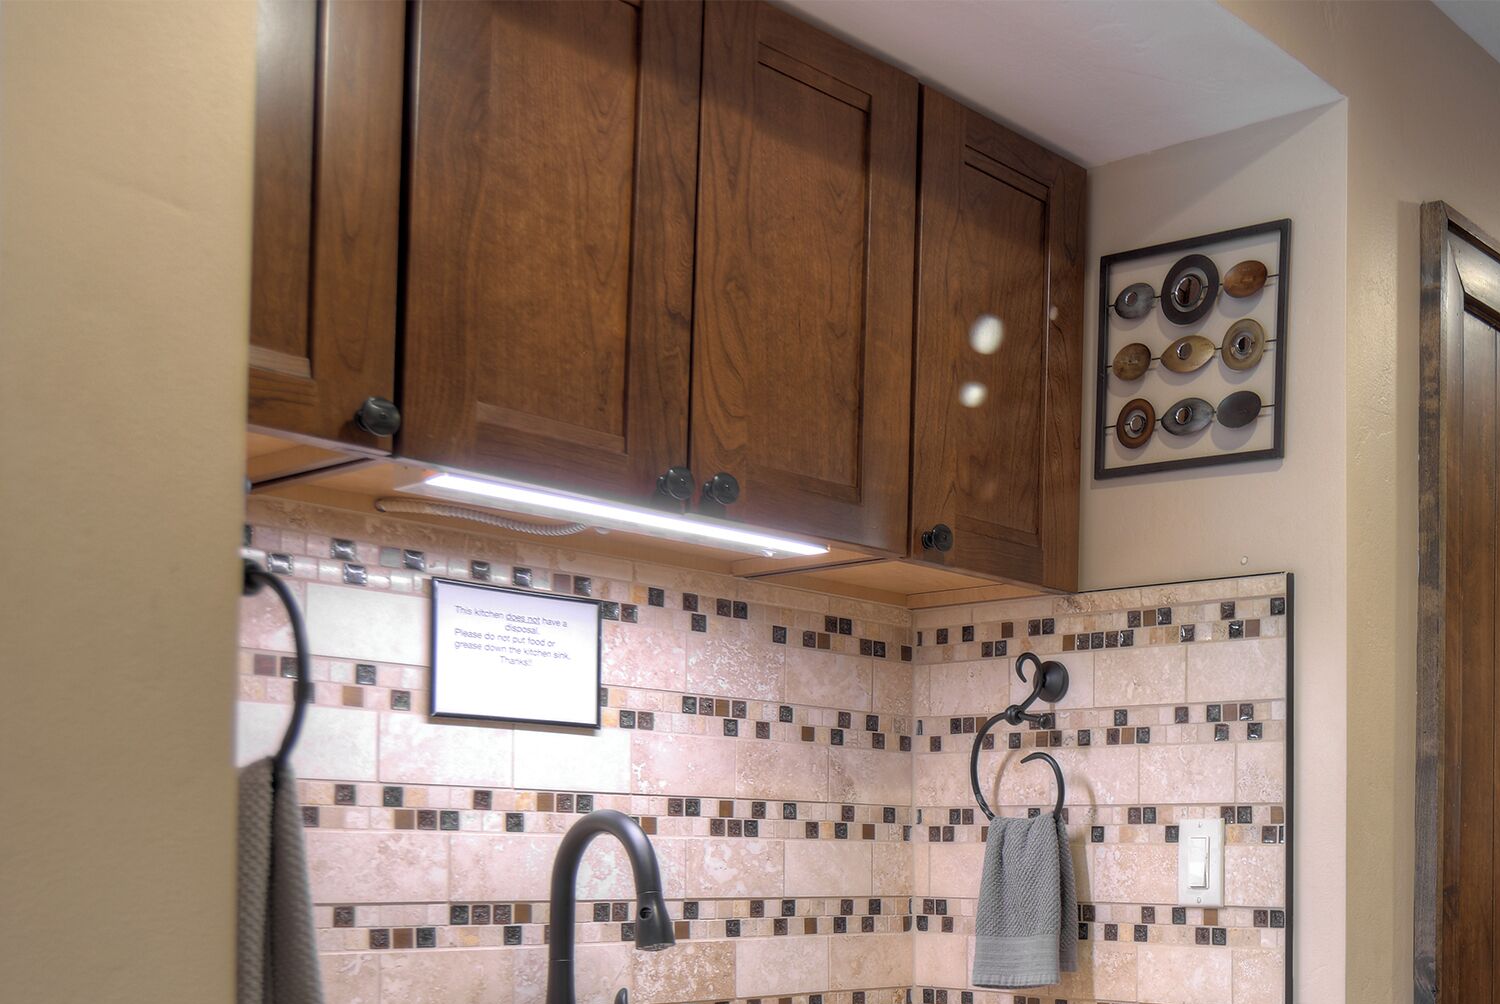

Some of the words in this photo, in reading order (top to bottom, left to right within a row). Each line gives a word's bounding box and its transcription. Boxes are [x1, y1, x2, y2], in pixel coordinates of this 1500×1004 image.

[455, 605, 472, 615] This
[474, 608, 504, 618] kitchen
[506, 613, 526, 623] does
[527, 615, 541, 625] not
[542, 617, 561, 627] have
[562, 620, 568, 628] a
[455, 628, 482, 639] Please
[484, 632, 496, 641] do
[497, 634, 511, 642] not
[512, 636, 526, 645] put
[527, 637, 545, 646] food
[547, 640, 556, 648] or
[455, 641, 482, 650] grease
[509, 646, 521, 654] the
[524, 648, 551, 657] kitchen
